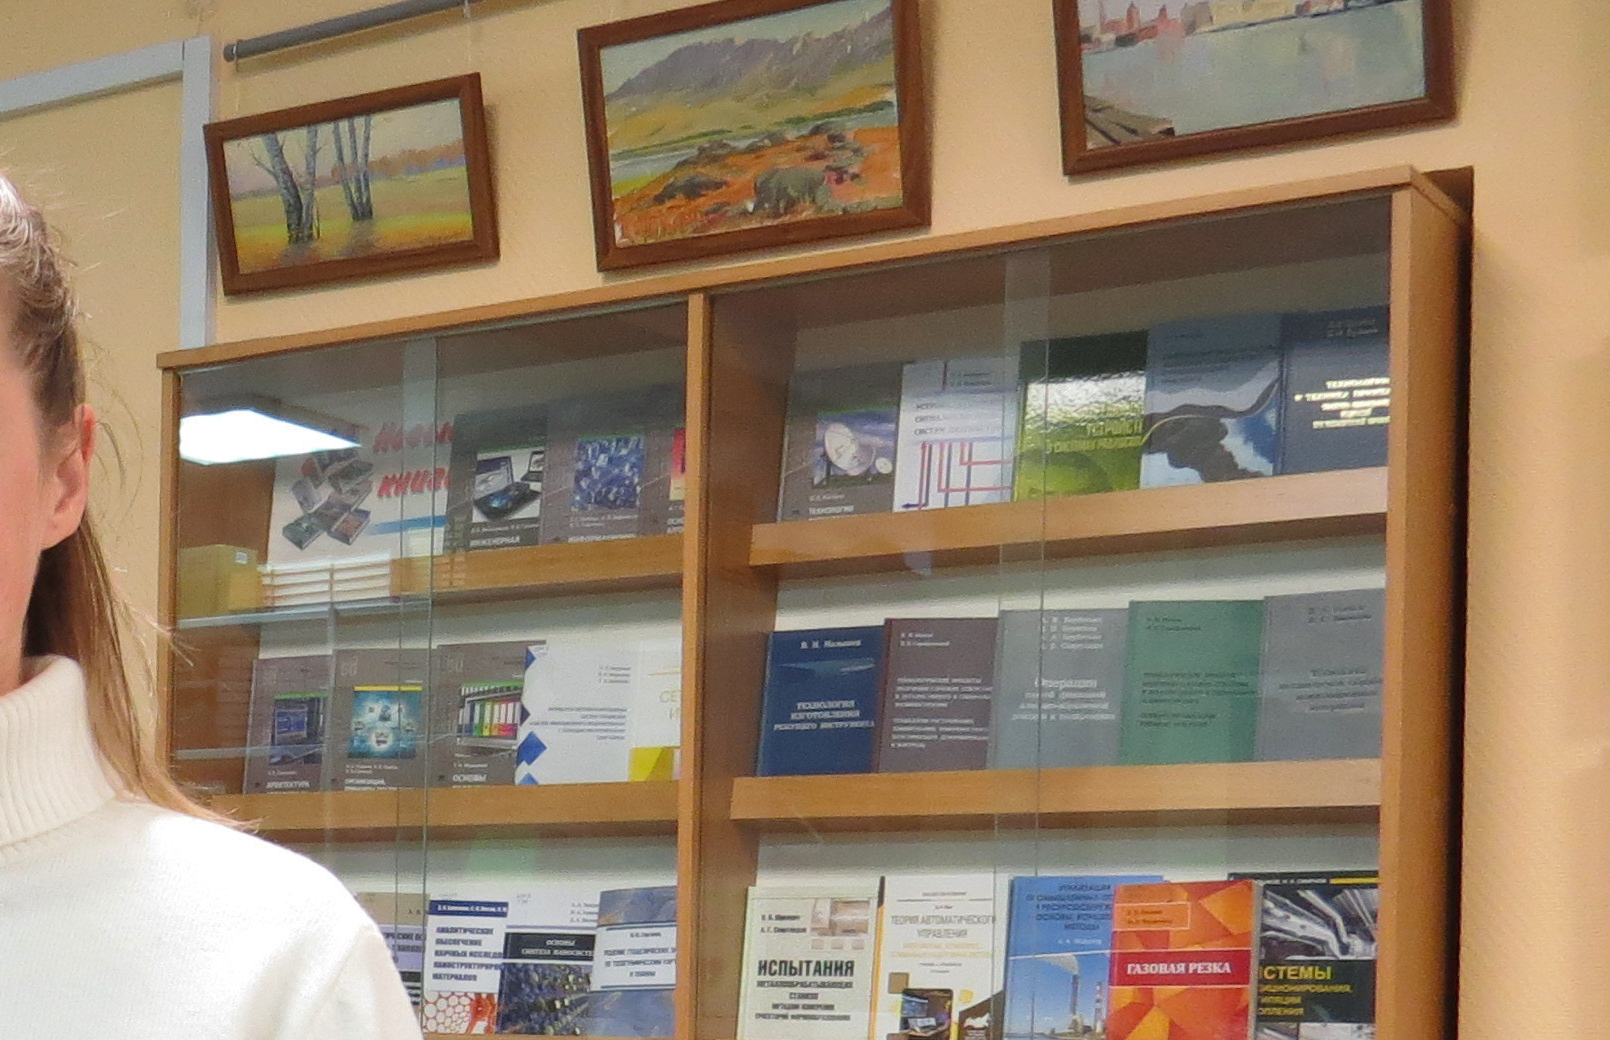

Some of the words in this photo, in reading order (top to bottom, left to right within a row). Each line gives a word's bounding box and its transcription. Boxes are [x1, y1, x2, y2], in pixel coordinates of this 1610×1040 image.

[758, 959, 855, 977] ИСПЫТАНИЯ
[1127, 962, 1186, 975] ГАЗОВАЯ
[1189, 961, 1231, 974] РЕЗКА
